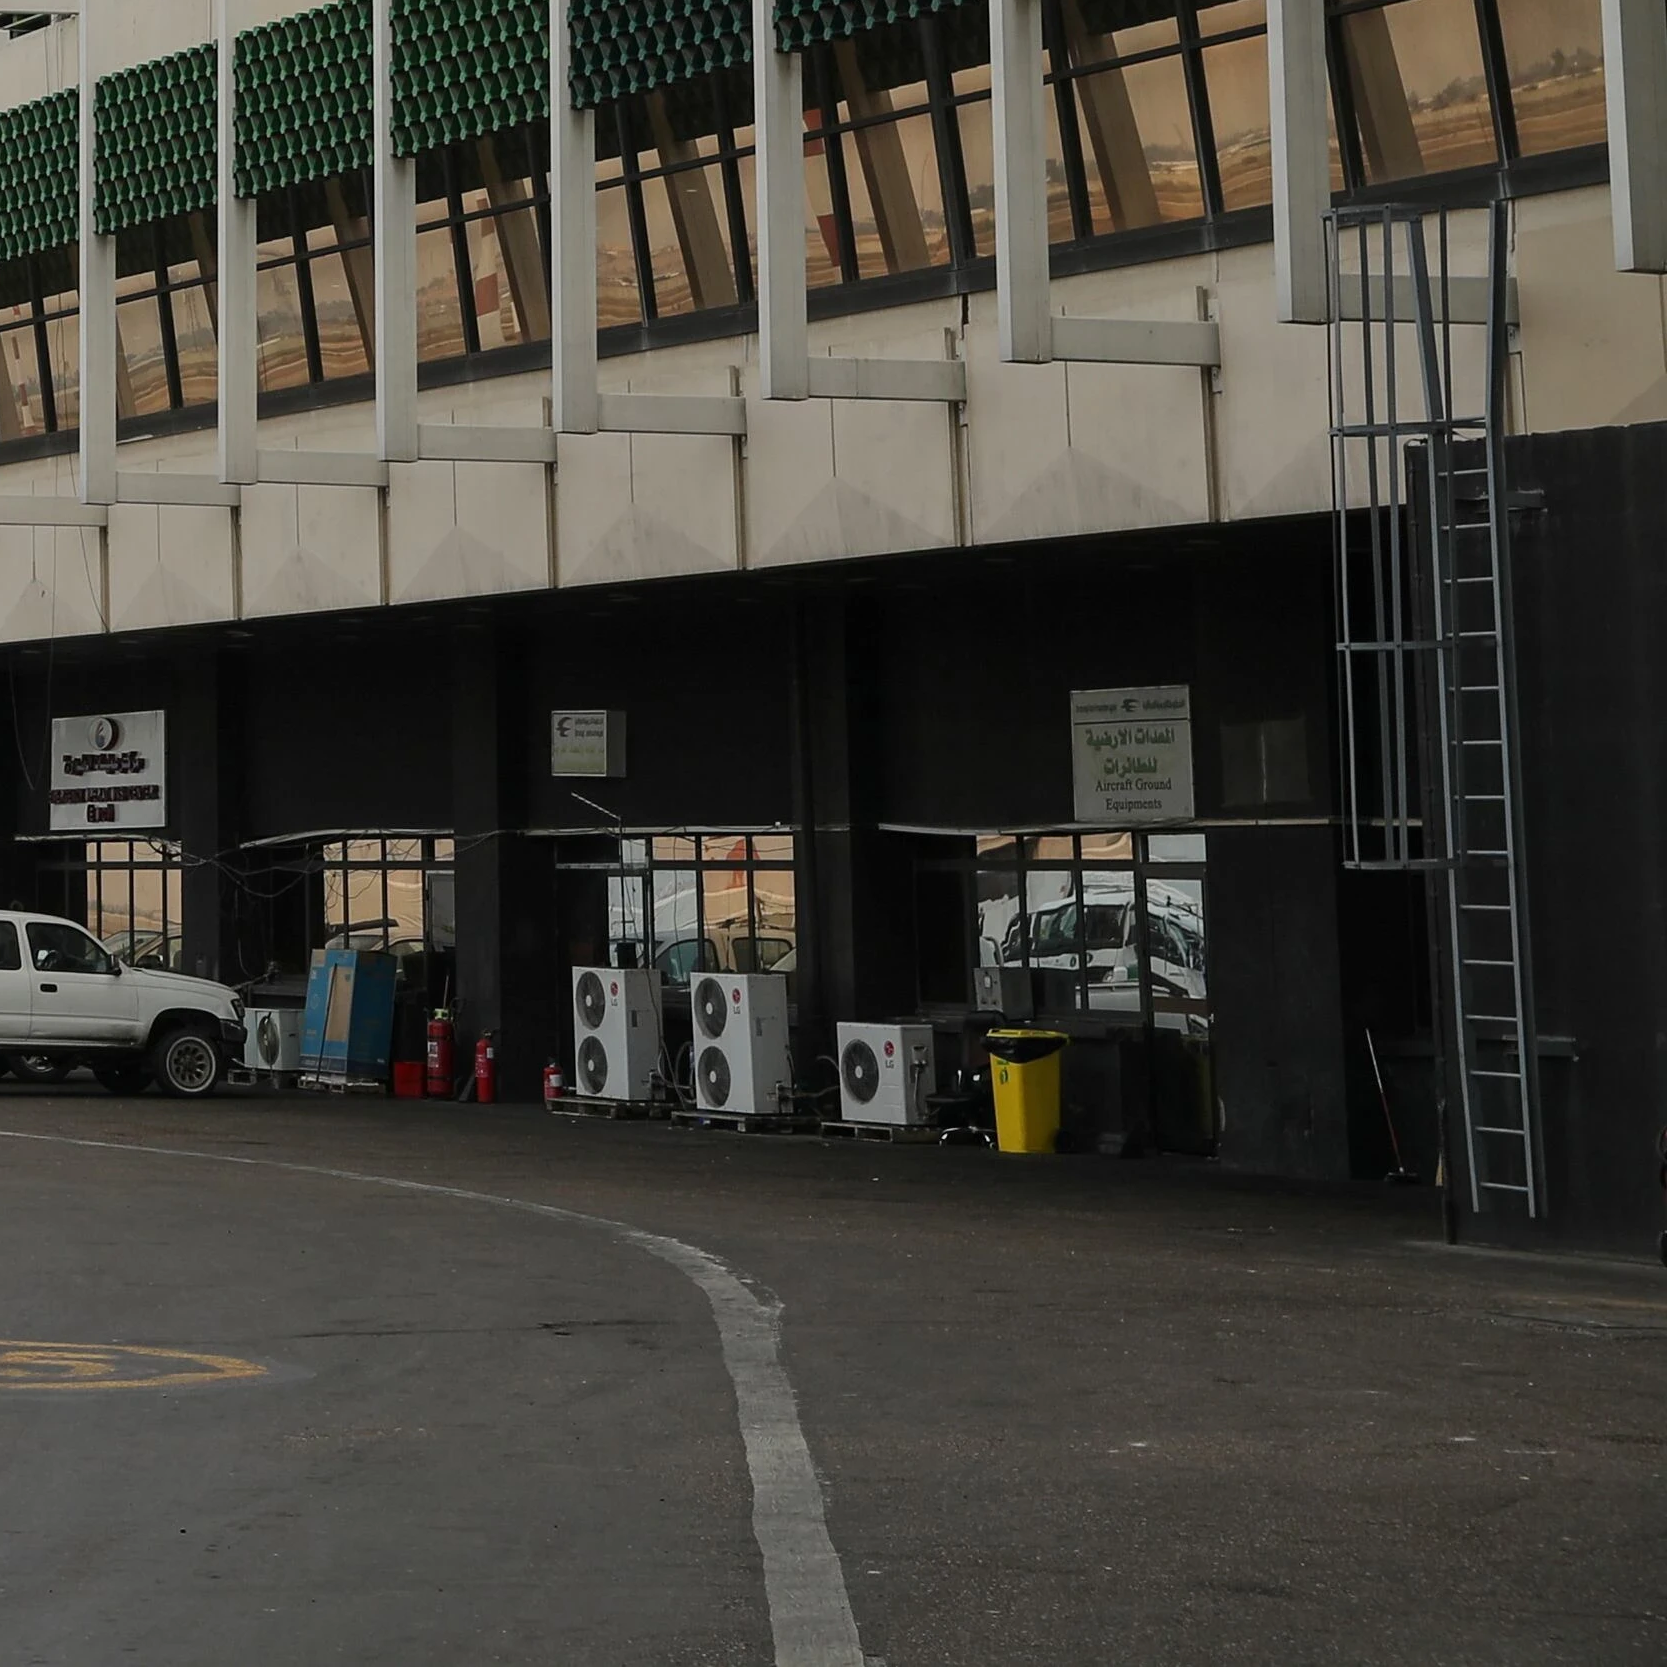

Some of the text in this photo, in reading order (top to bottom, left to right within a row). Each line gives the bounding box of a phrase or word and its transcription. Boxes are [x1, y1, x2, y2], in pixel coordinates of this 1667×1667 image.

[1095, 778, 1172, 792] Aircraft Ground
[1106, 798, 1162, 813] Equipments
